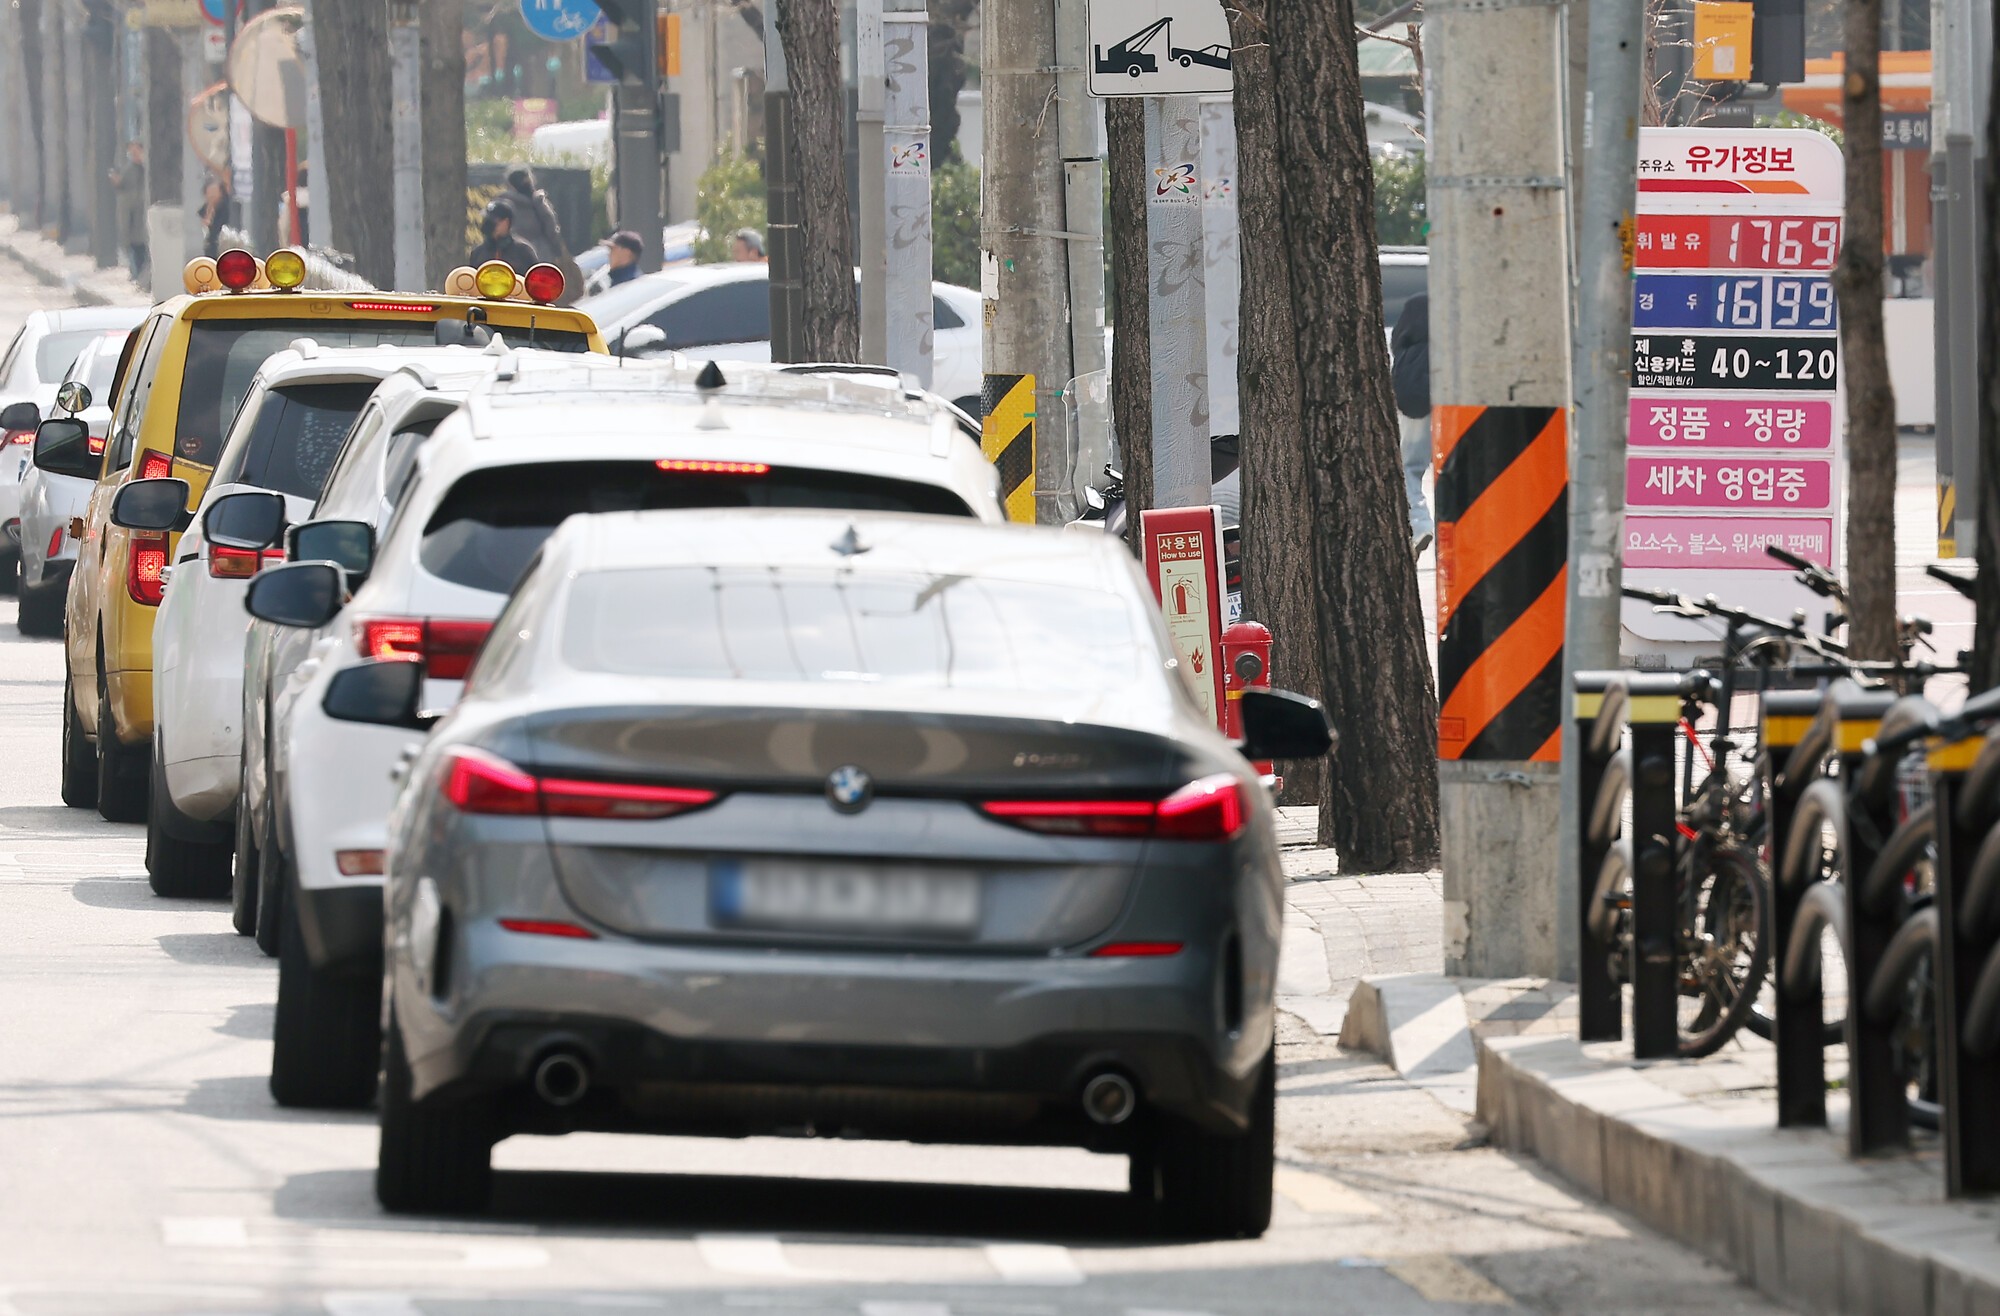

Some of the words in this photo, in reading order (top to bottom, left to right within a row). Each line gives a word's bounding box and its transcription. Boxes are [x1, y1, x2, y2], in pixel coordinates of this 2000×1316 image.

[1639, 159, 1675, 173] 주유소
[1685, 146, 1796, 174] 유가정보
[1729, 220, 1838, 266] 1769
[1716, 280, 1834, 326] 1699
[1634, 356, 1696, 373] 신용카드
[1711, 348, 1836, 380] 40~120
[1649, 406, 1711, 441] 정품
[1744, 408, 1807, 442] 정량
[1645, 465, 1707, 495] 세차
[1716, 467, 1807, 501] 영업중
[1161, 551, 1178, 560] How
[1188, 550, 1201, 558] use
[1627, 531, 1683, 553] 요소수,
[1688, 533, 1727, 555] 불스,
[1787, 534, 1824, 555] 판매
